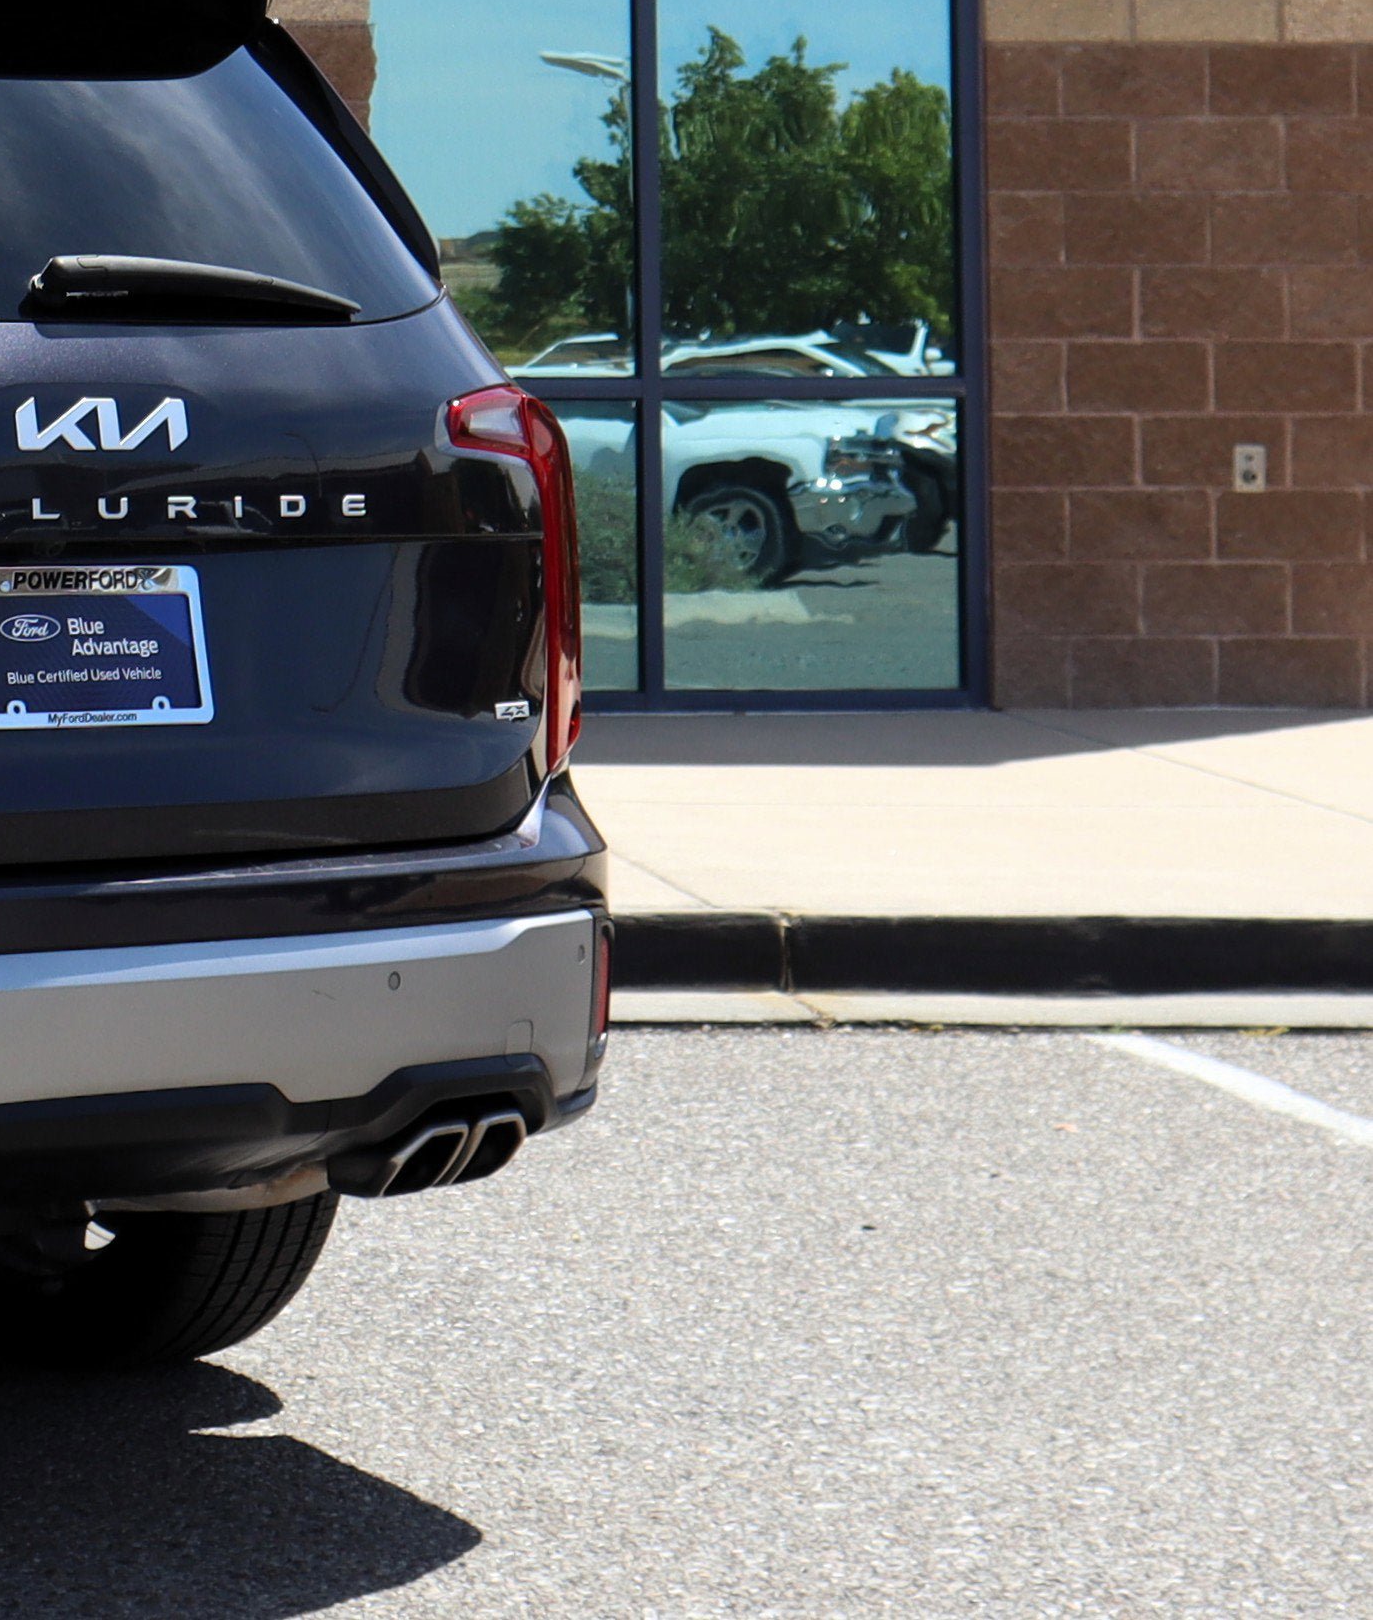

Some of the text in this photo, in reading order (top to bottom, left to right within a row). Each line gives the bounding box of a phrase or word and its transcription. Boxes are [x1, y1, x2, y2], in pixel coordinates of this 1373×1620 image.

[14, 395, 190, 452] KIA
[12, 570, 138, 591] POWERFORD
[11, 618, 49, 637] Ford
[67, 617, 104, 635] Blue
[72, 637, 159, 658] Advantage
[7, 666, 162, 685] Blue Certified Used Vehicle
[47, 712, 138, 727] MyFordDealer.com
